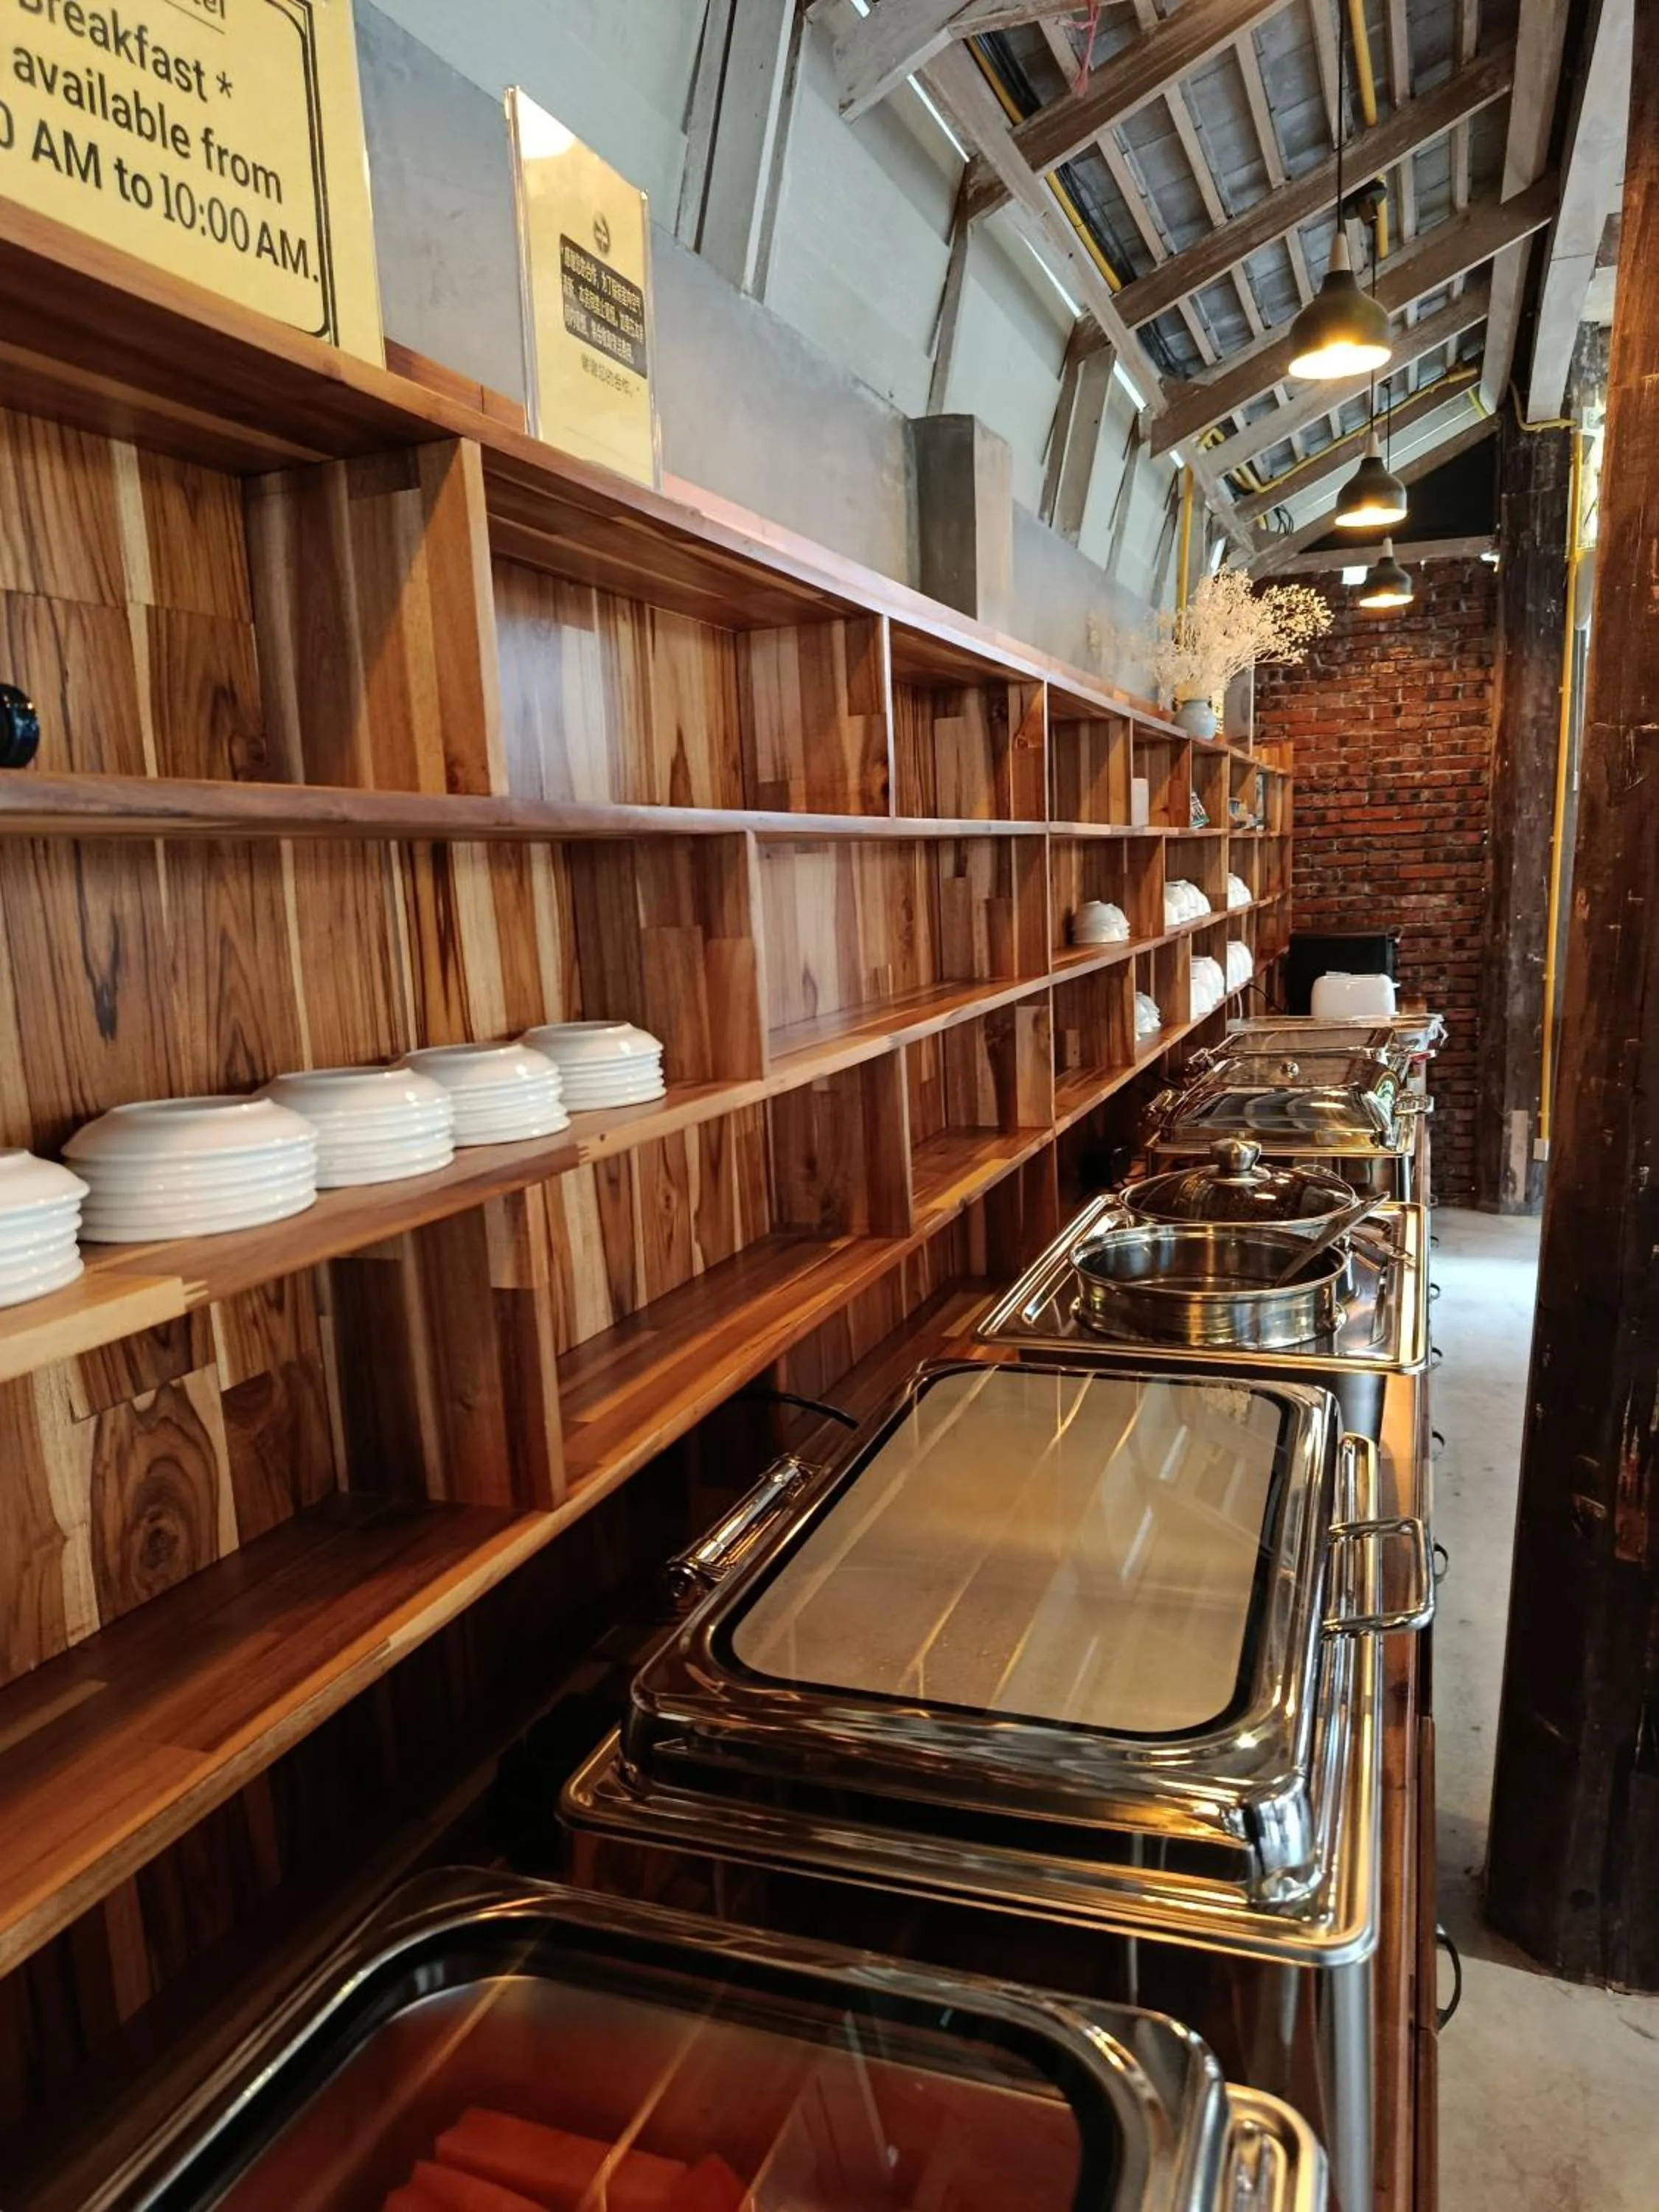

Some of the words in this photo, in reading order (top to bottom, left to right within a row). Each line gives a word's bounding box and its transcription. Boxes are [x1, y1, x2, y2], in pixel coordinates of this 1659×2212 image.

[13, 46, 190, 159] available
[201, 128, 282, 204] from
[31, 118, 102, 190] AM
[114, 157, 153, 209] to
